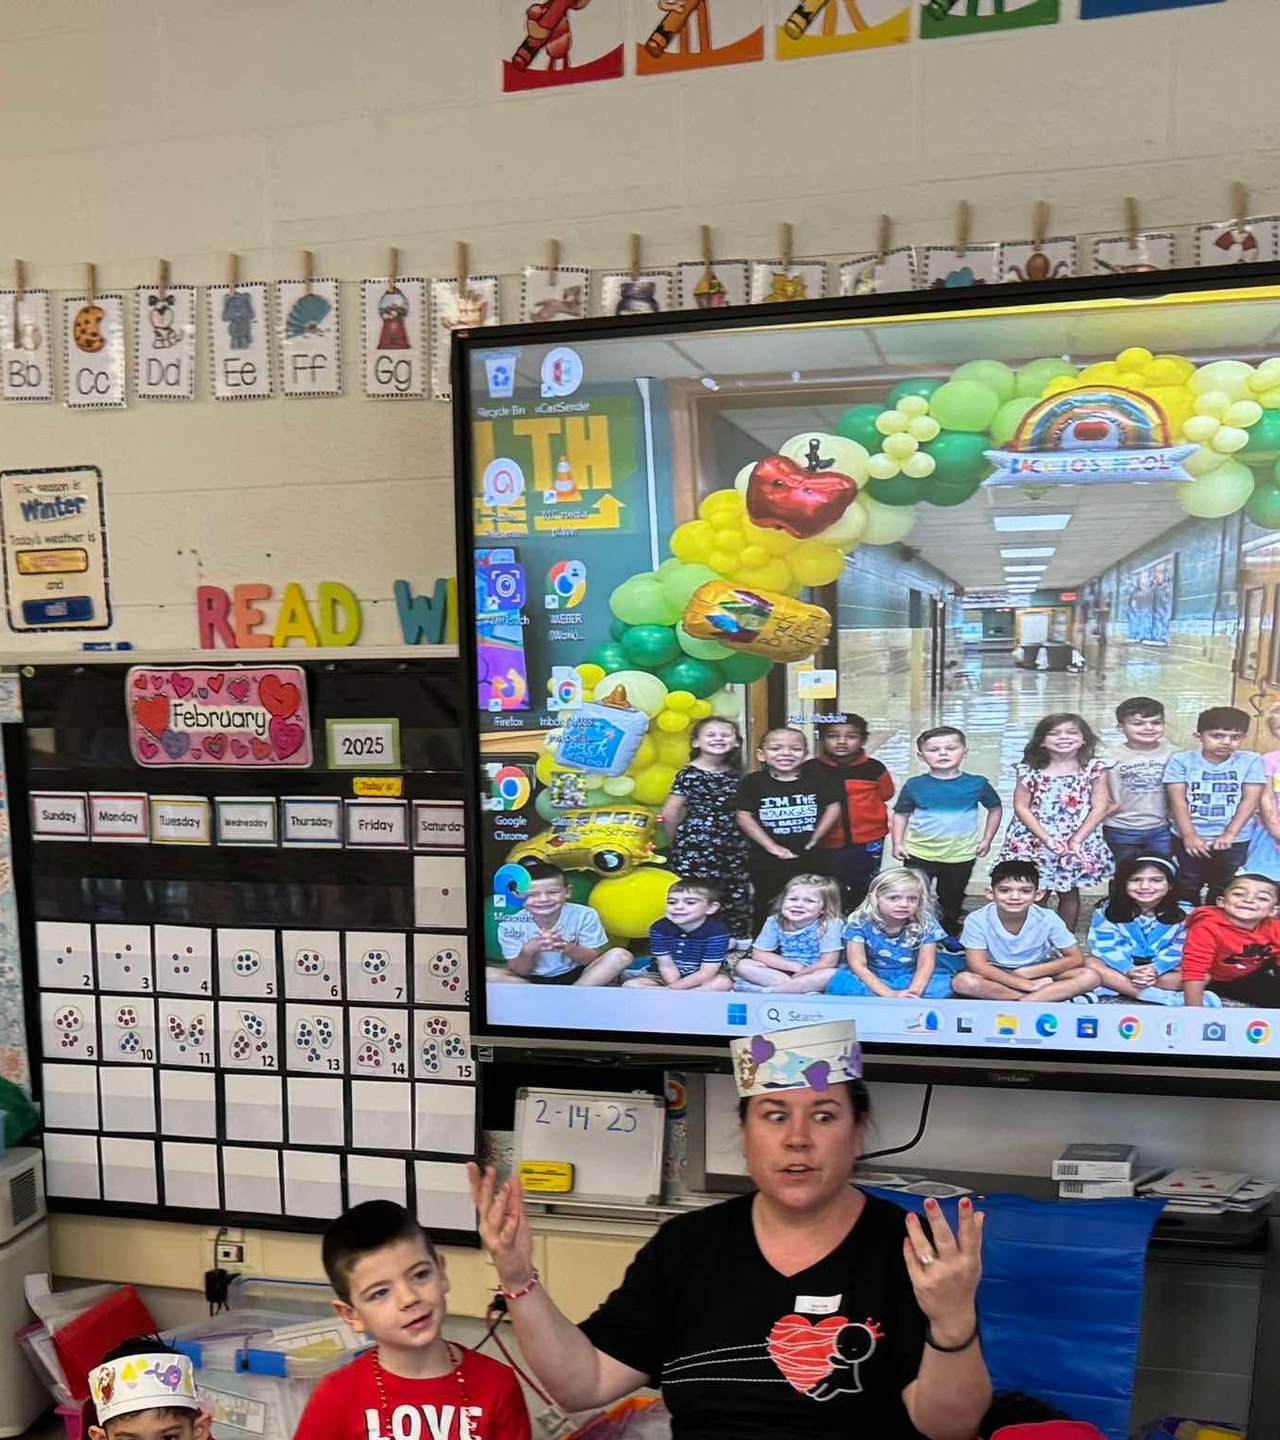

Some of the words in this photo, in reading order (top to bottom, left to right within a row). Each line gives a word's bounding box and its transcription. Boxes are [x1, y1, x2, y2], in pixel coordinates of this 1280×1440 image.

[9, 361, 41, 388] Bb
[147, 359, 181, 386] Dd
[225, 359, 257, 387] Ee
[292, 355, 327, 382] Ff
[375, 357, 413, 391] Gg
[76, 368, 110, 395] Cc
[512, 405, 526, 416] Bin
[20, 495, 87, 522] Winter
[197, 581, 363, 649] READ
[172, 702, 268, 735] February
[342, 737, 385, 756] 2025
[42, 810, 77, 824] Sunday
[98, 811, 139, 825] Monday
[159, 815, 201, 829] Tuesday
[224, 818, 268, 829] Wednesday
[290, 816, 334, 830] Thursday
[493, 815, 528, 828] Google
[358, 818, 395, 833] Friday
[494, 830, 529, 841] Chrome
[82, 975, 91, 987] 2
[141, 977, 150, 990] 3
[200, 979, 209, 992] 4
[266, 982, 274, 994] 5
[330, 984, 339, 997] 6
[395, 987, 404, 999] 7
[86, 1045, 94, 1057] 9
[140, 1048, 153, 1061] 10
[199, 1052, 210, 1064] 11
[261, 1054, 275, 1067] 12
[326, 1058, 341, 1071] 13
[391, 1061, 406, 1075] 14
[457, 1065, 473, 1078] 15
[534, 1098, 639, 1134] 2-14-25
